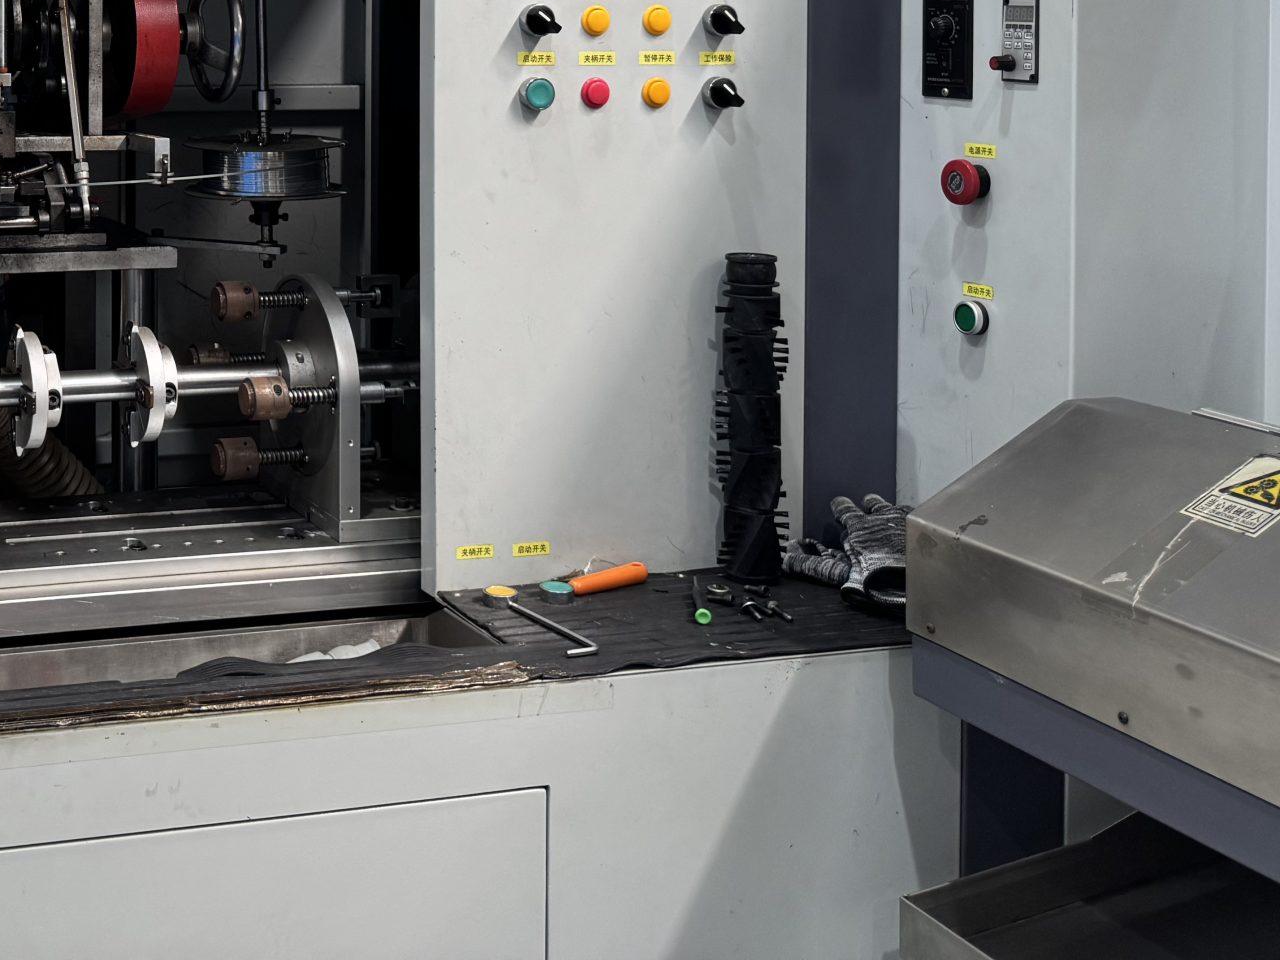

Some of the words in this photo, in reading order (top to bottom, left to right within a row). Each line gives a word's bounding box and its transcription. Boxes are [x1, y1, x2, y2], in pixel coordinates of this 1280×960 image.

[522, 54, 552, 63] 启动开关
[644, 54, 672, 62] 暂停开关
[517, 544, 548, 554] 启动开关
